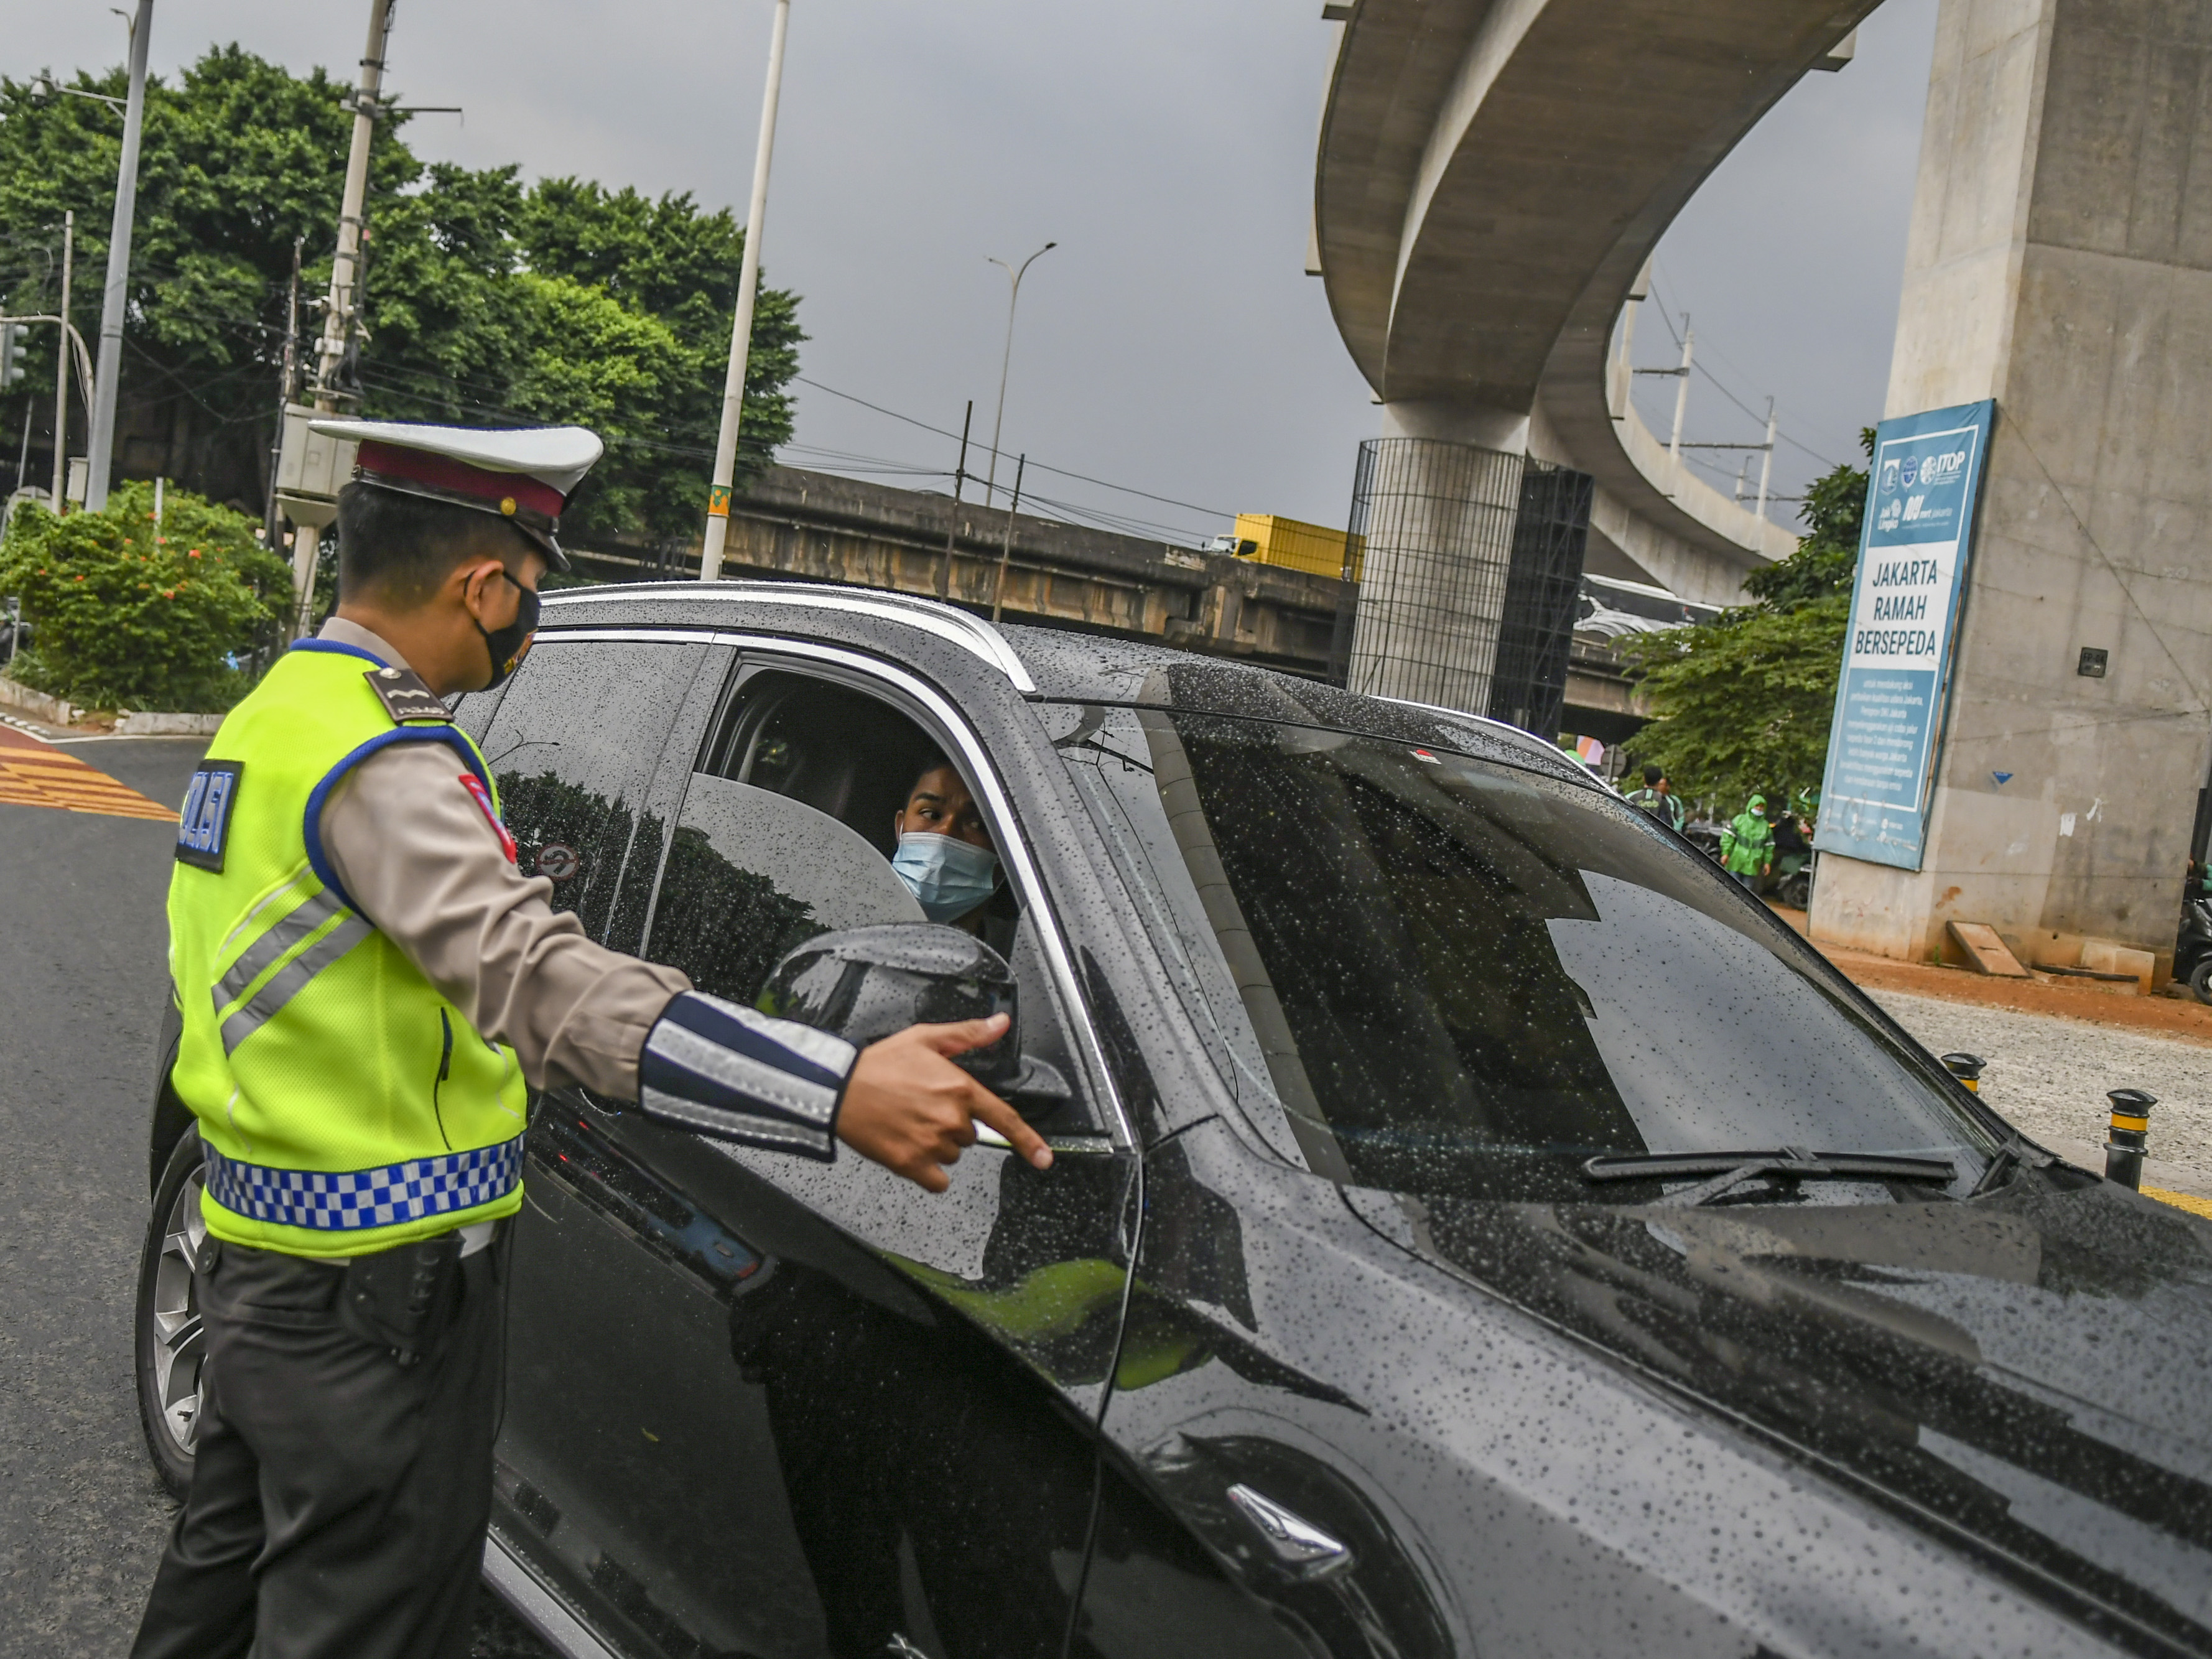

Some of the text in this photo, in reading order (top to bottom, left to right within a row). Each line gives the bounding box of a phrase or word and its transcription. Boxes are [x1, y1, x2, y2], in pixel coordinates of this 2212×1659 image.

[1872, 559, 1937, 587] JAKARTA
[1874, 595, 1928, 621] RAMAH
[1855, 630, 1936, 656] BERSEPEDA
